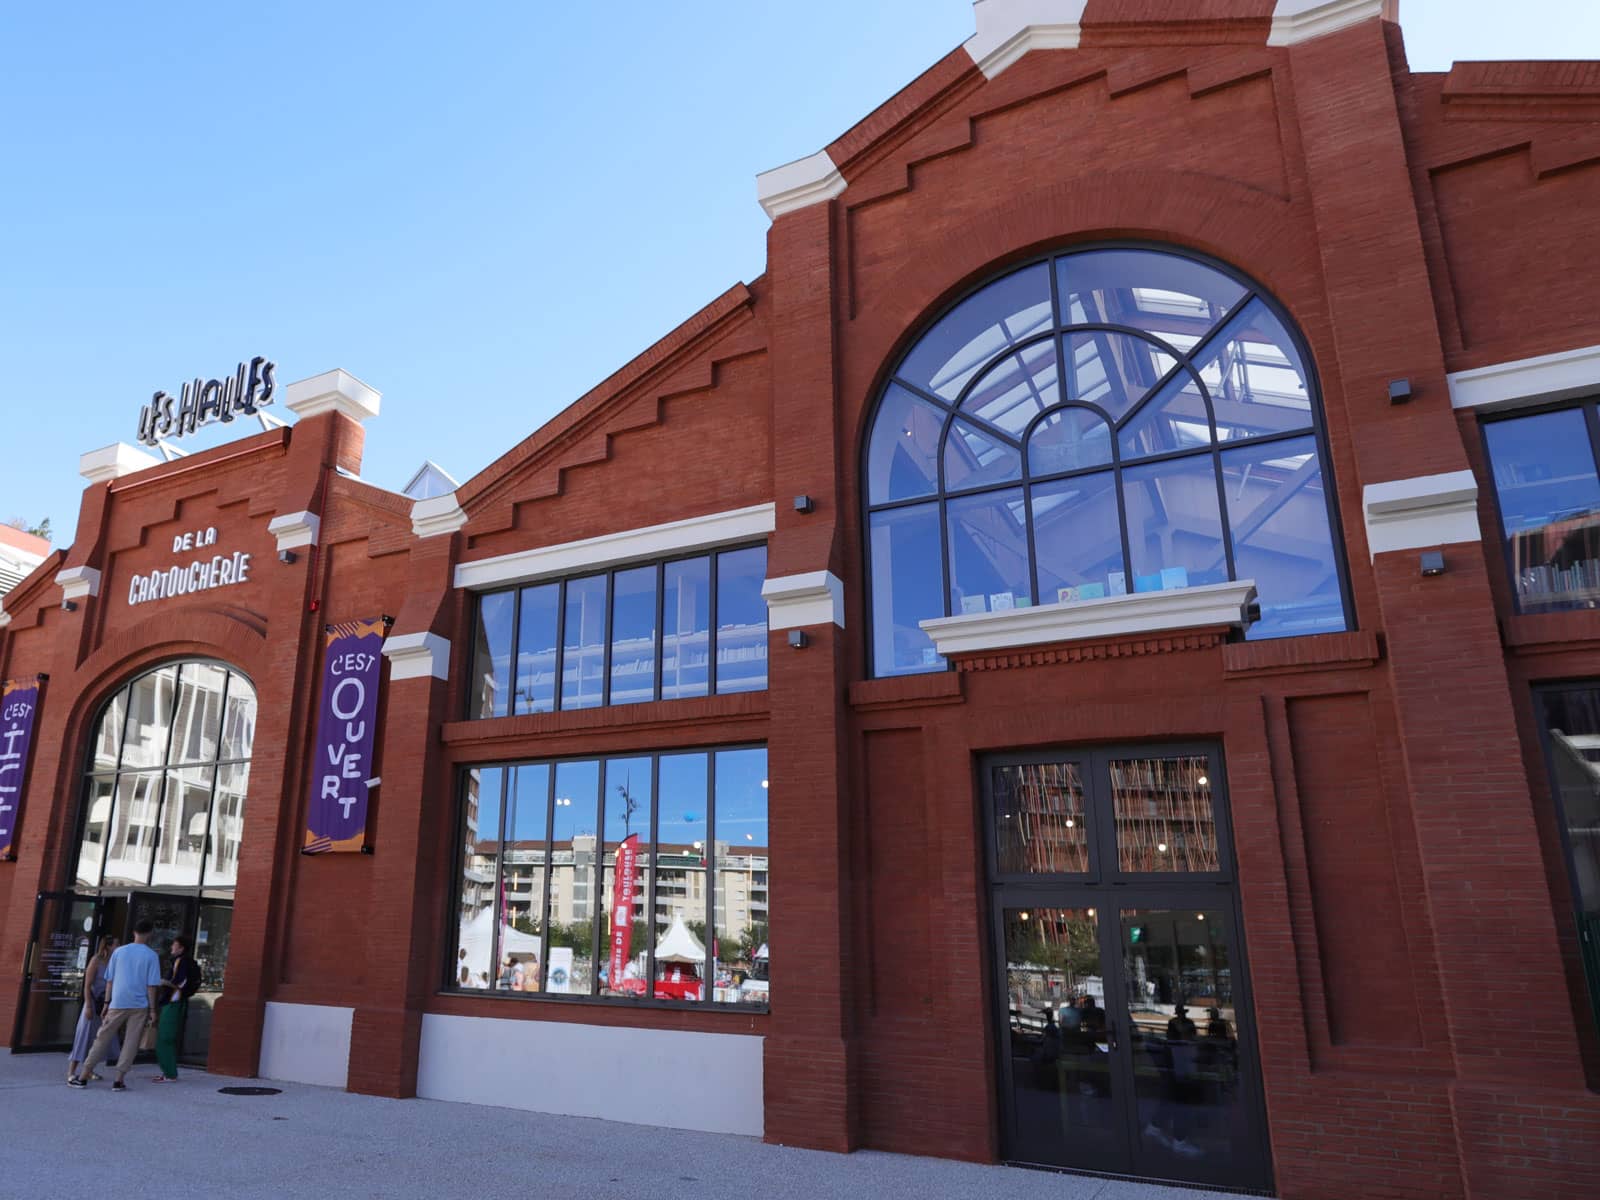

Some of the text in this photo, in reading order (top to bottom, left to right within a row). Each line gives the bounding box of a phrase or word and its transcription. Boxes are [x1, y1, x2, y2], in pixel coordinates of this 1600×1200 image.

[137, 356, 277, 447] LES HALLES
[172, 527, 217, 553] DE LA
[128, 551, 250, 606] CARTOUCHERIE
[331, 653, 375, 676] C'EST
[4, 703, 33, 721] C'EST
[321, 677, 365, 820] OUVERT
